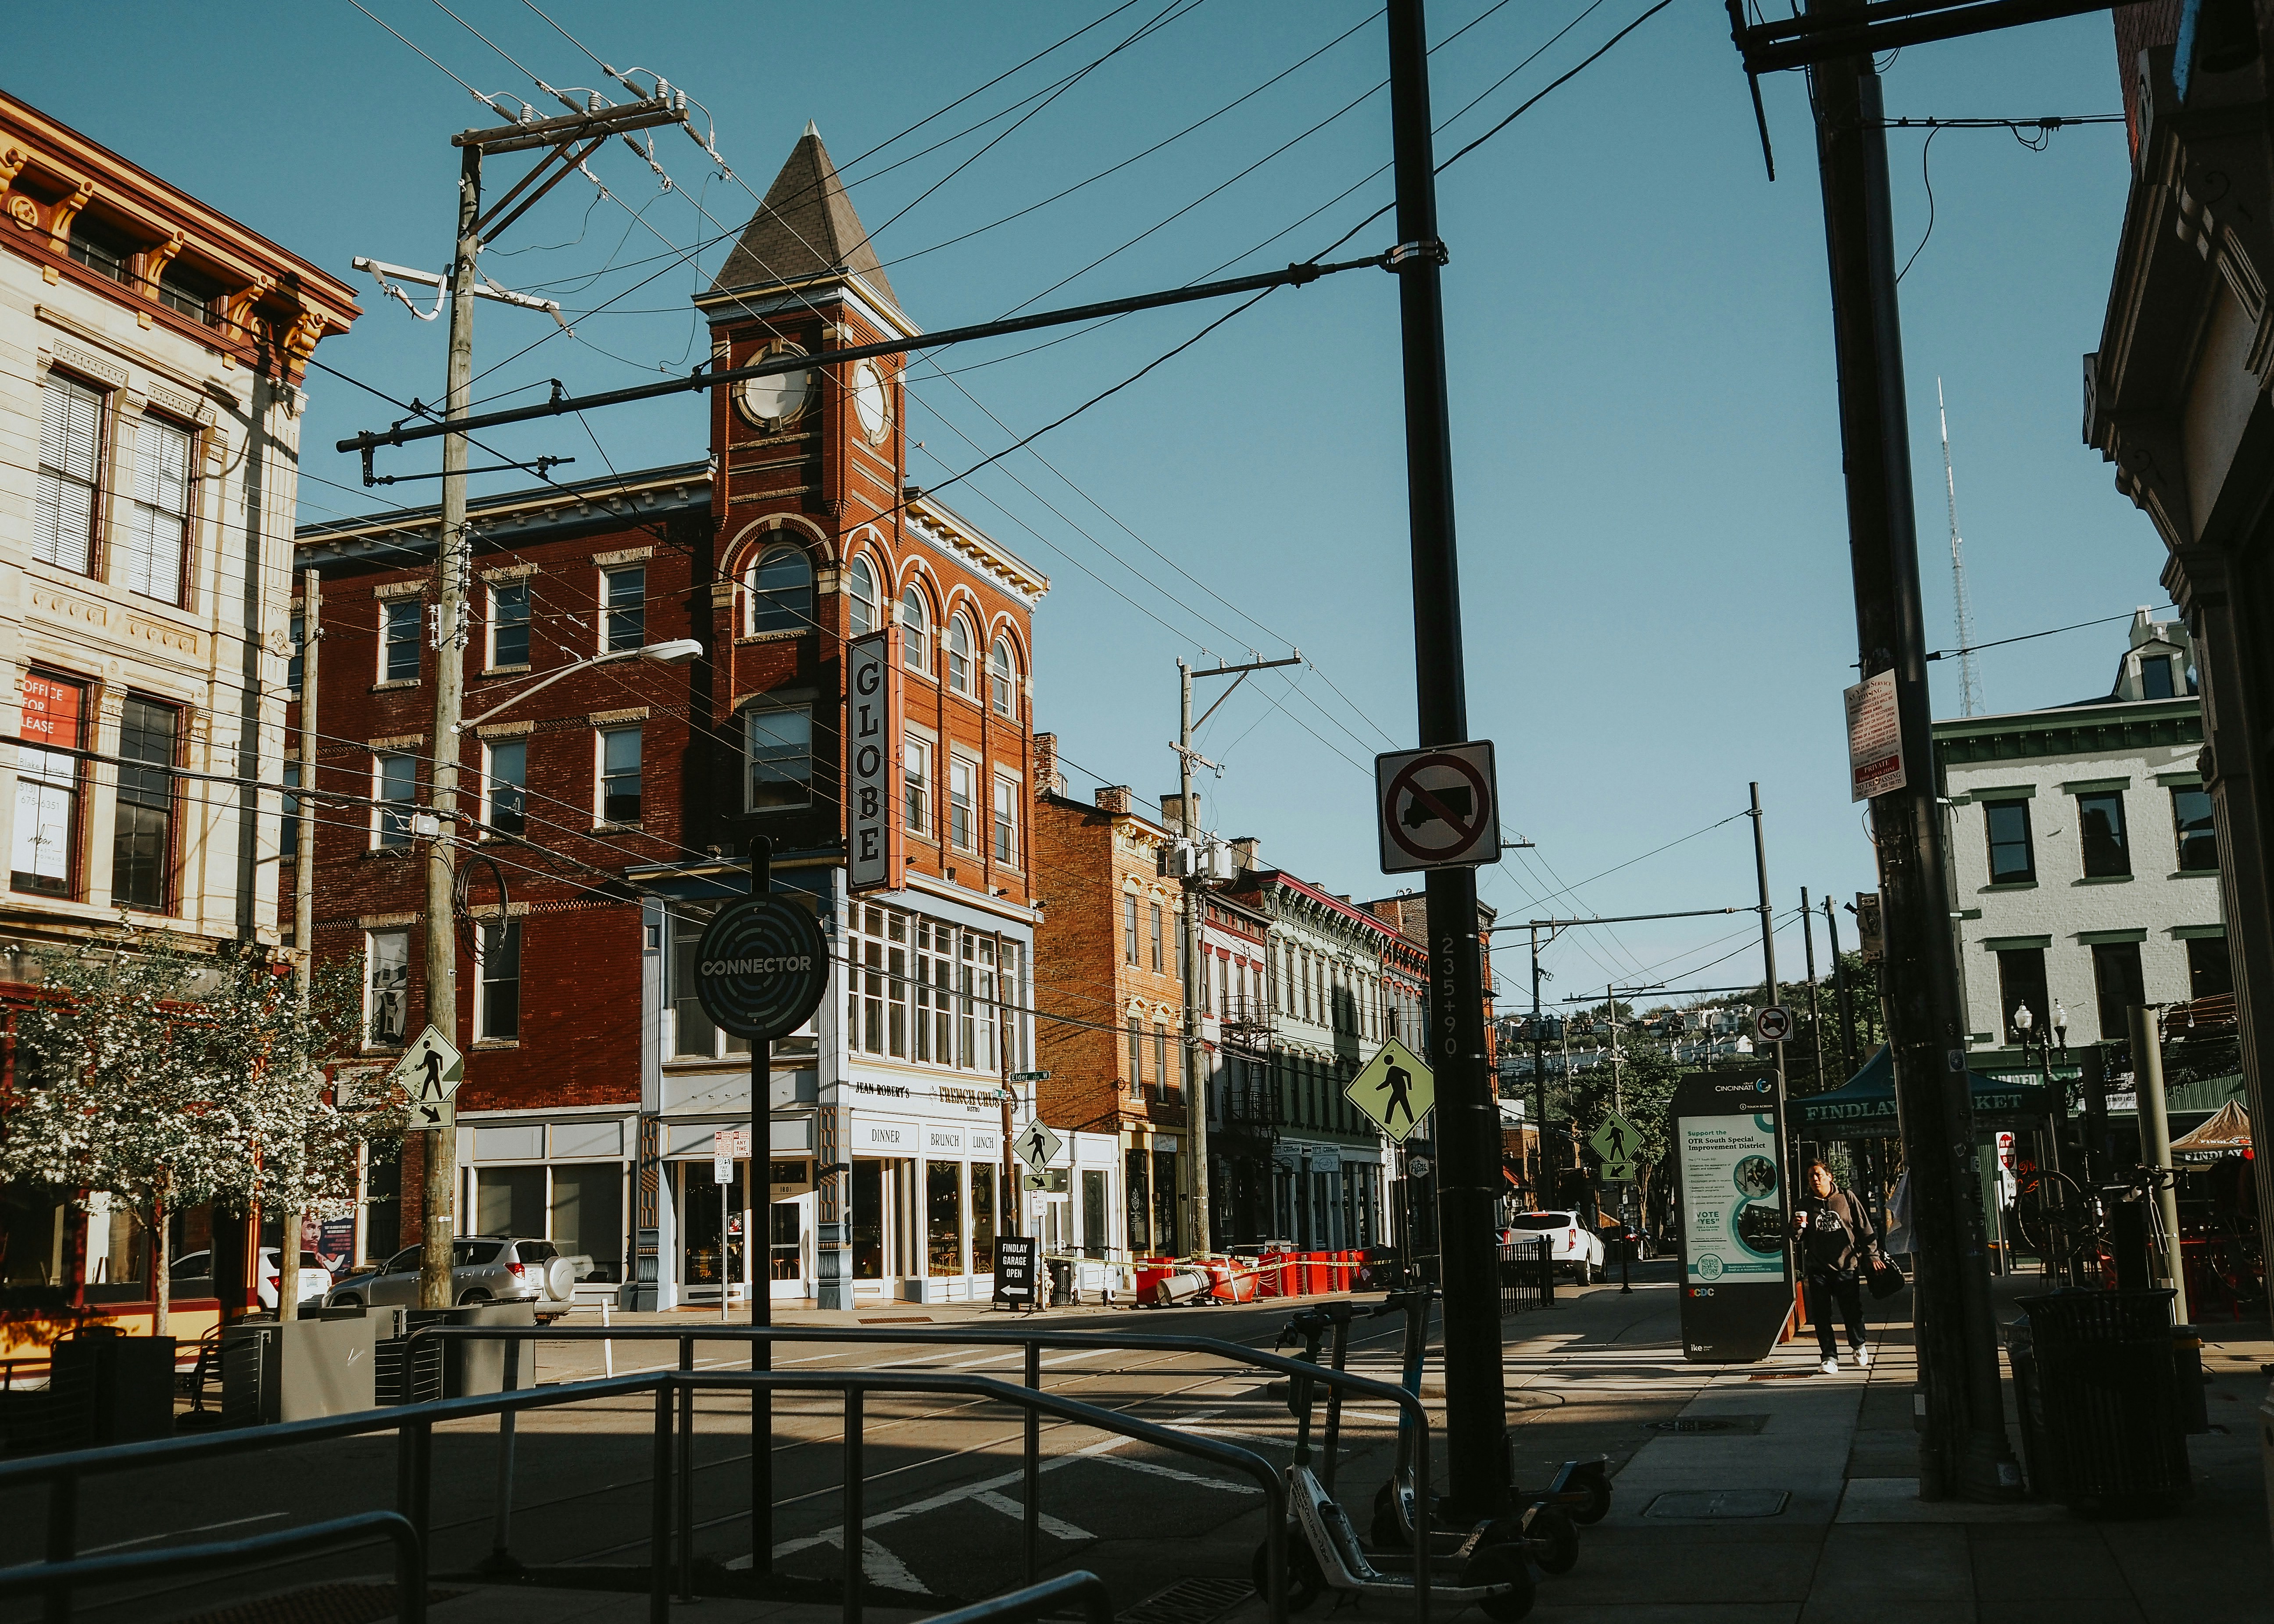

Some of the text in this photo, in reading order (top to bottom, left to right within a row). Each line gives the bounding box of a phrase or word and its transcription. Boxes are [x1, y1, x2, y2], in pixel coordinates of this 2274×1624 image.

[25, 680, 63, 701] OFFICE
[22, 697, 45, 714] FOR
[21, 714, 54, 734] LEASE
[19, 758, 40, 767] Blake
[856, 661, 880, 863] GLOBE
[1864, 758, 1889, 774] PRIVATE
[1856, 783, 1864, 792] NO
[1865, 770, 1901, 789] TREPASSING
[701, 956, 812, 976] CONNECTOR
[855, 1081, 874, 1095] JEAN
[939, 1086, 975, 1105] FRENCH
[977, 1090, 1000, 1107] CRUS
[1805, 1100, 1898, 1121] FINDLAY
[872, 1128, 900, 1143] DINNER
[930, 1133, 959, 1147] BRUNCH
[973, 1136, 994, 1149] LUNCH
[1688, 1144, 1736, 1152] Improvement
[2185, 1149, 2243, 1161] FINDLAY
[1003, 1243, 1027, 1253] FINDLAY
[1003, 1256, 1027, 1266] GARAGE
[1006, 1268, 1022, 1278] OPEN
[1688, 1288, 1714, 1298] 3CDC
[1305, 1507, 1311, 1520] On
[1309, 1519, 1318, 1538] Lime
[1319, 1542, 1330, 1563] Uber
